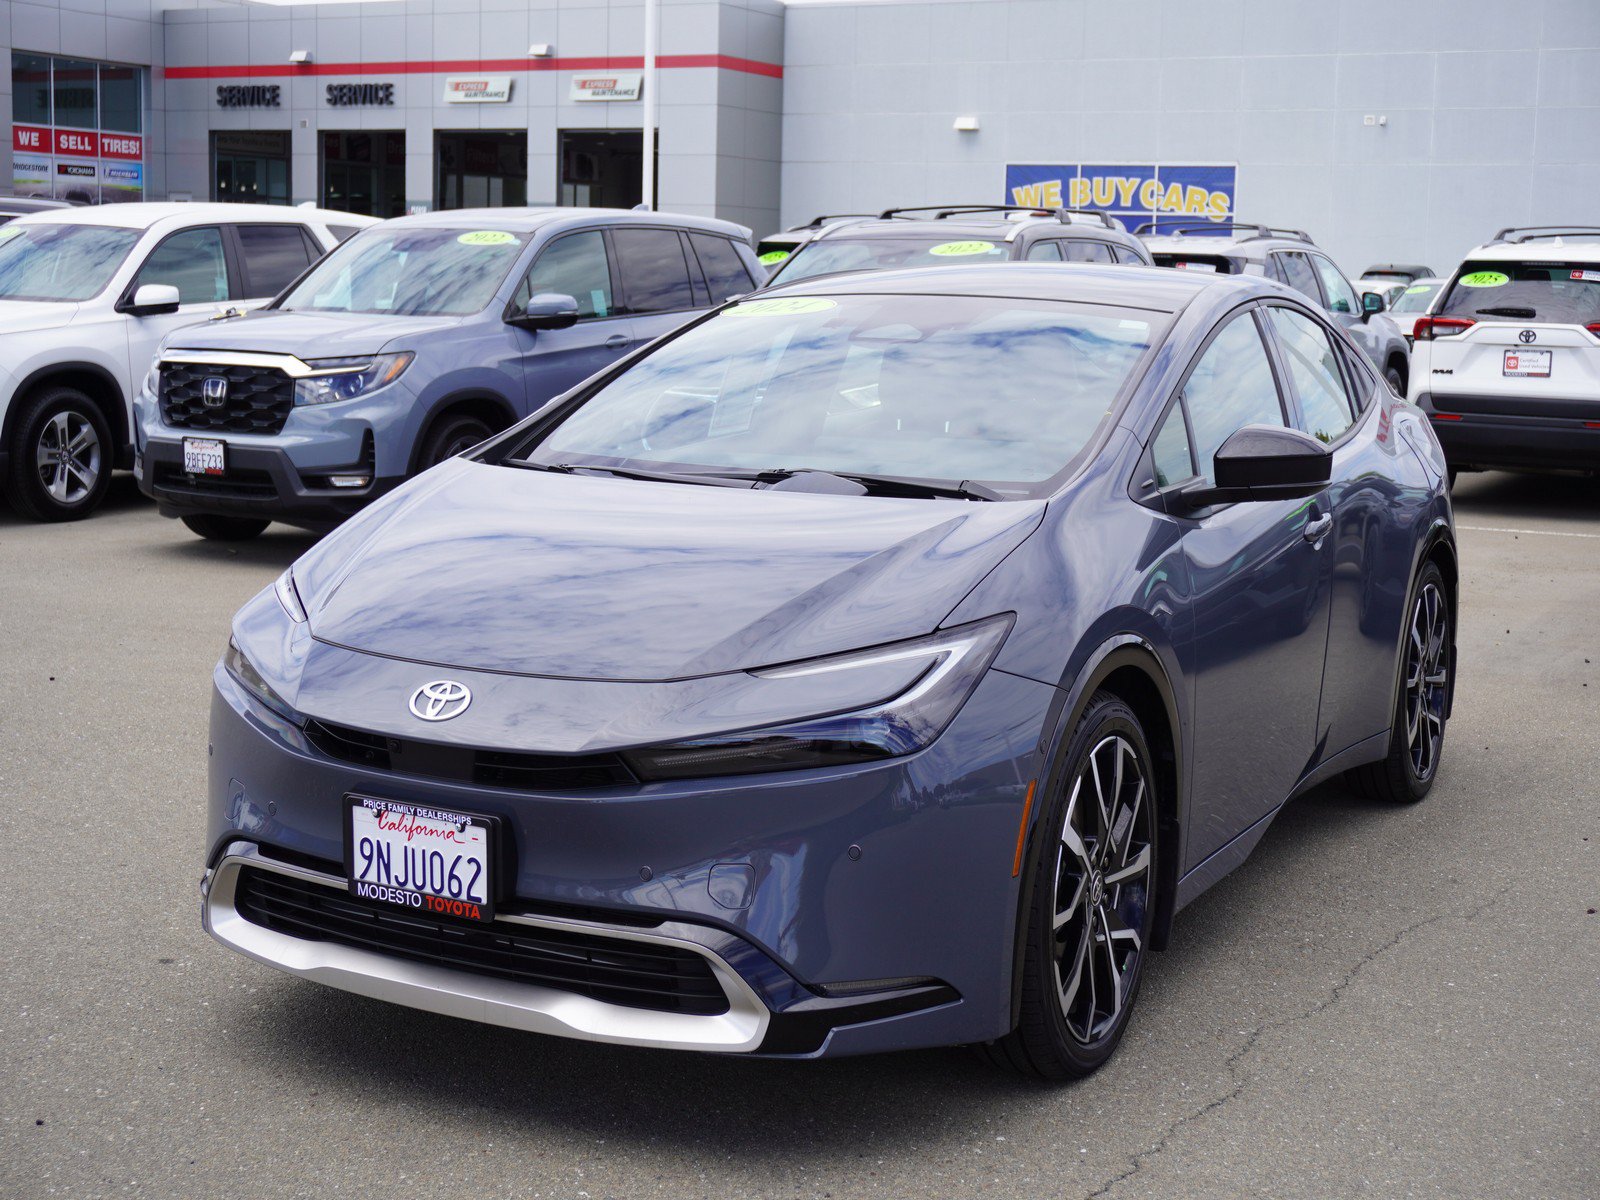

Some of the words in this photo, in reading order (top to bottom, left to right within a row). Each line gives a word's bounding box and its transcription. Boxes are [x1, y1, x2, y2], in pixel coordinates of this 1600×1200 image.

[216, 85, 281, 107] SERVICE
[326, 83, 395, 106] SERVICE
[464, 91, 505, 99] MAINTENANCE
[592, 88, 636, 96] MAINTENANCE
[18, 131, 40, 147] WE
[60, 135, 92, 151] SELL
[102, 138, 140, 155] TIRES!
[1012, 179, 1064, 208] WE
[1069, 176, 1141, 207] BUY
[1139, 178, 1231, 222] CARS
[363, 800, 386, 811] PRICE
[388, 804, 415, 816] FAMILY
[416, 808, 472, 826] DEALERSHIPS
[377, 809, 466, 843] California
[359, 836, 483, 903] 9NJU062
[357, 882, 422, 907] MODESTO
[426, 895, 481, 920] TOYOTA
